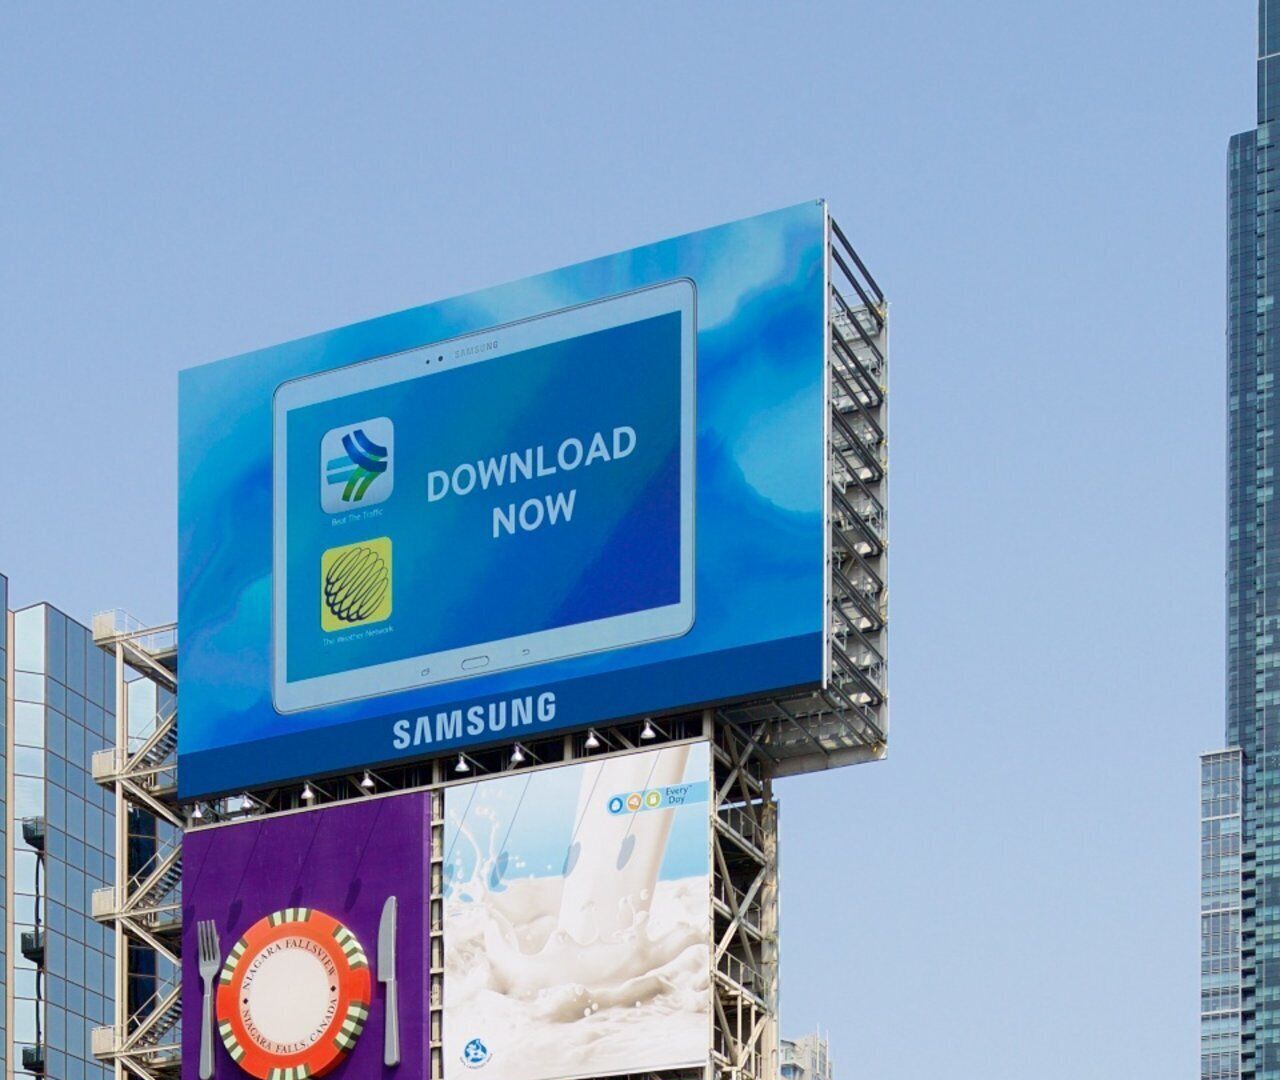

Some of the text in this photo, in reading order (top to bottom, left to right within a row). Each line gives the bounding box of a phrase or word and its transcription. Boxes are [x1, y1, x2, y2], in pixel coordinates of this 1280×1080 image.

[454, 340, 499, 359] SAMSUNG
[427, 425, 638, 503] DOWNLOAD
[492, 489, 578, 539] NOW
[392, 691, 557, 751] SAMSUNG
[243, 938, 337, 991] NIAGARA FALLSVIEW
[242, 998, 338, 1050] NIAGARA CANADA
